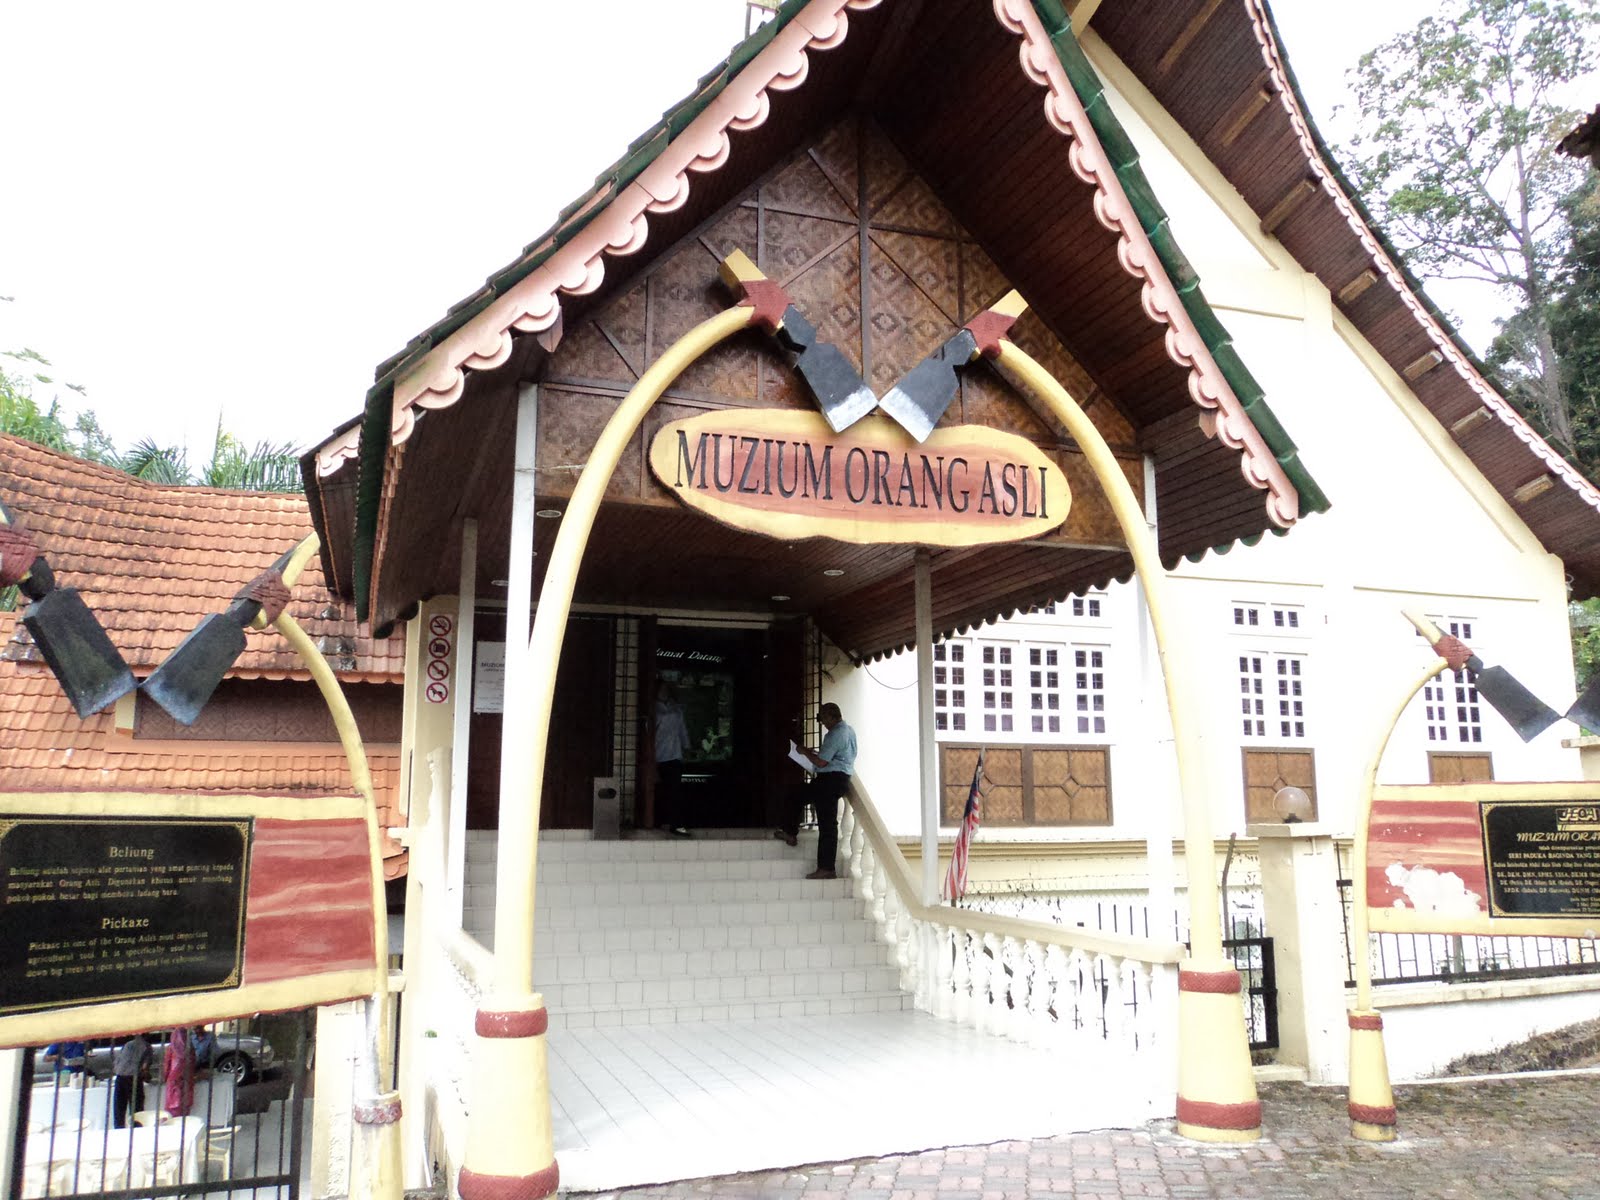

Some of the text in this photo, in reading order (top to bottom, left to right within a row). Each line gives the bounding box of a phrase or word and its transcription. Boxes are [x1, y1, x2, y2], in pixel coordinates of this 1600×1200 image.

[675, 429, 1049, 519] MUZIUM ORANG ASLI
[108, 846, 155, 860] Beliung
[59, 879, 83, 889] Orang
[102, 917, 150, 929] Pickaxe
[114, 936, 136, 944] Orang
